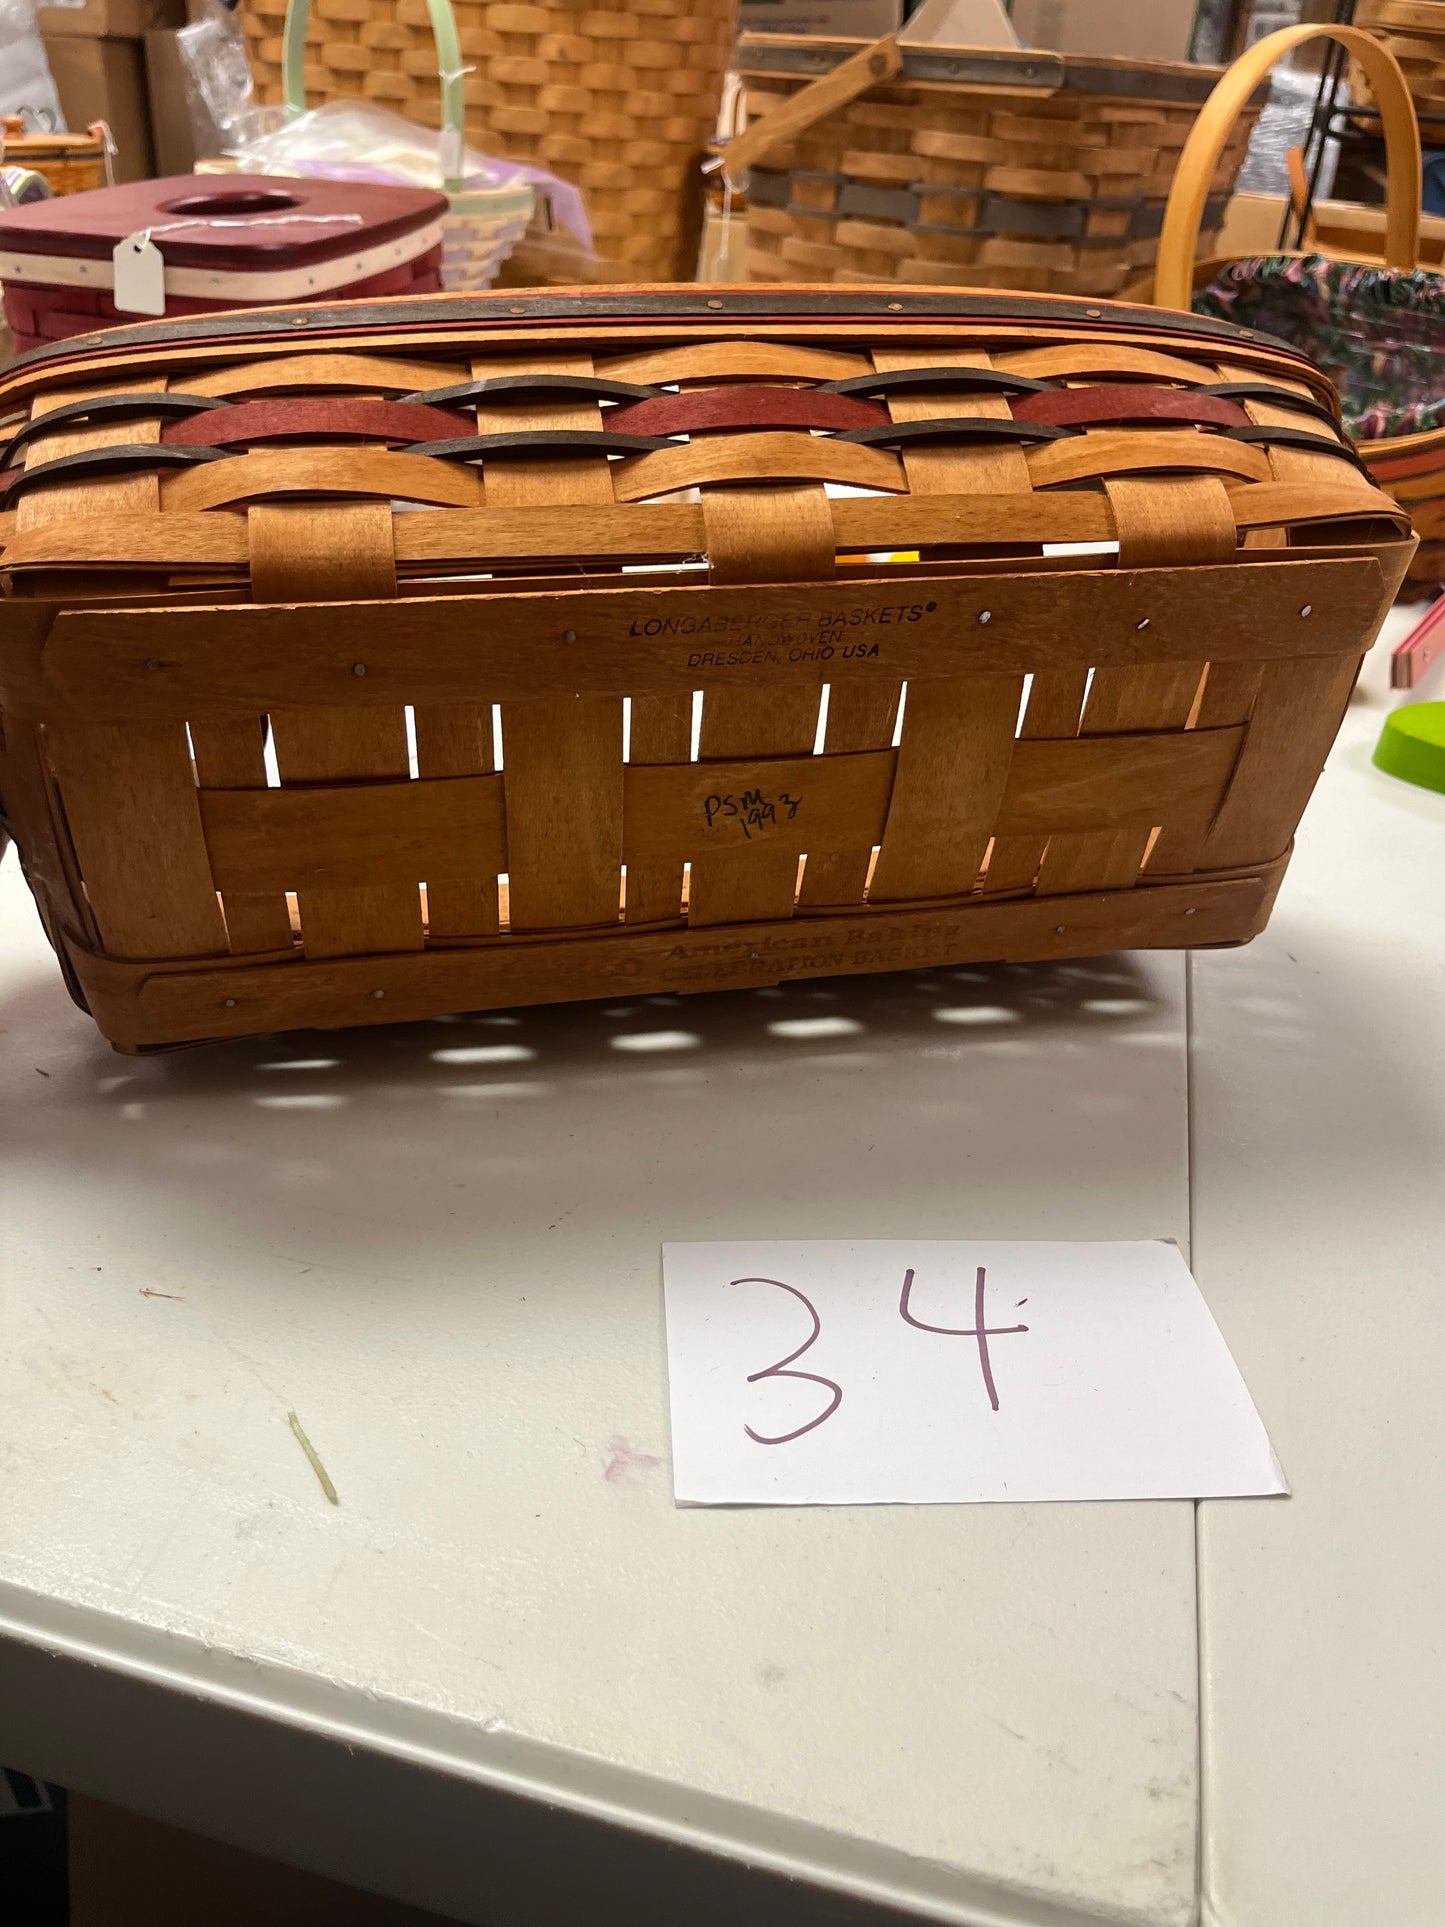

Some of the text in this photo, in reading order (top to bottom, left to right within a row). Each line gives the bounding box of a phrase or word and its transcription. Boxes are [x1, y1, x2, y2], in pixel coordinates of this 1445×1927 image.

[688, 643, 880, 667] DRESDEN, OHIO USA
